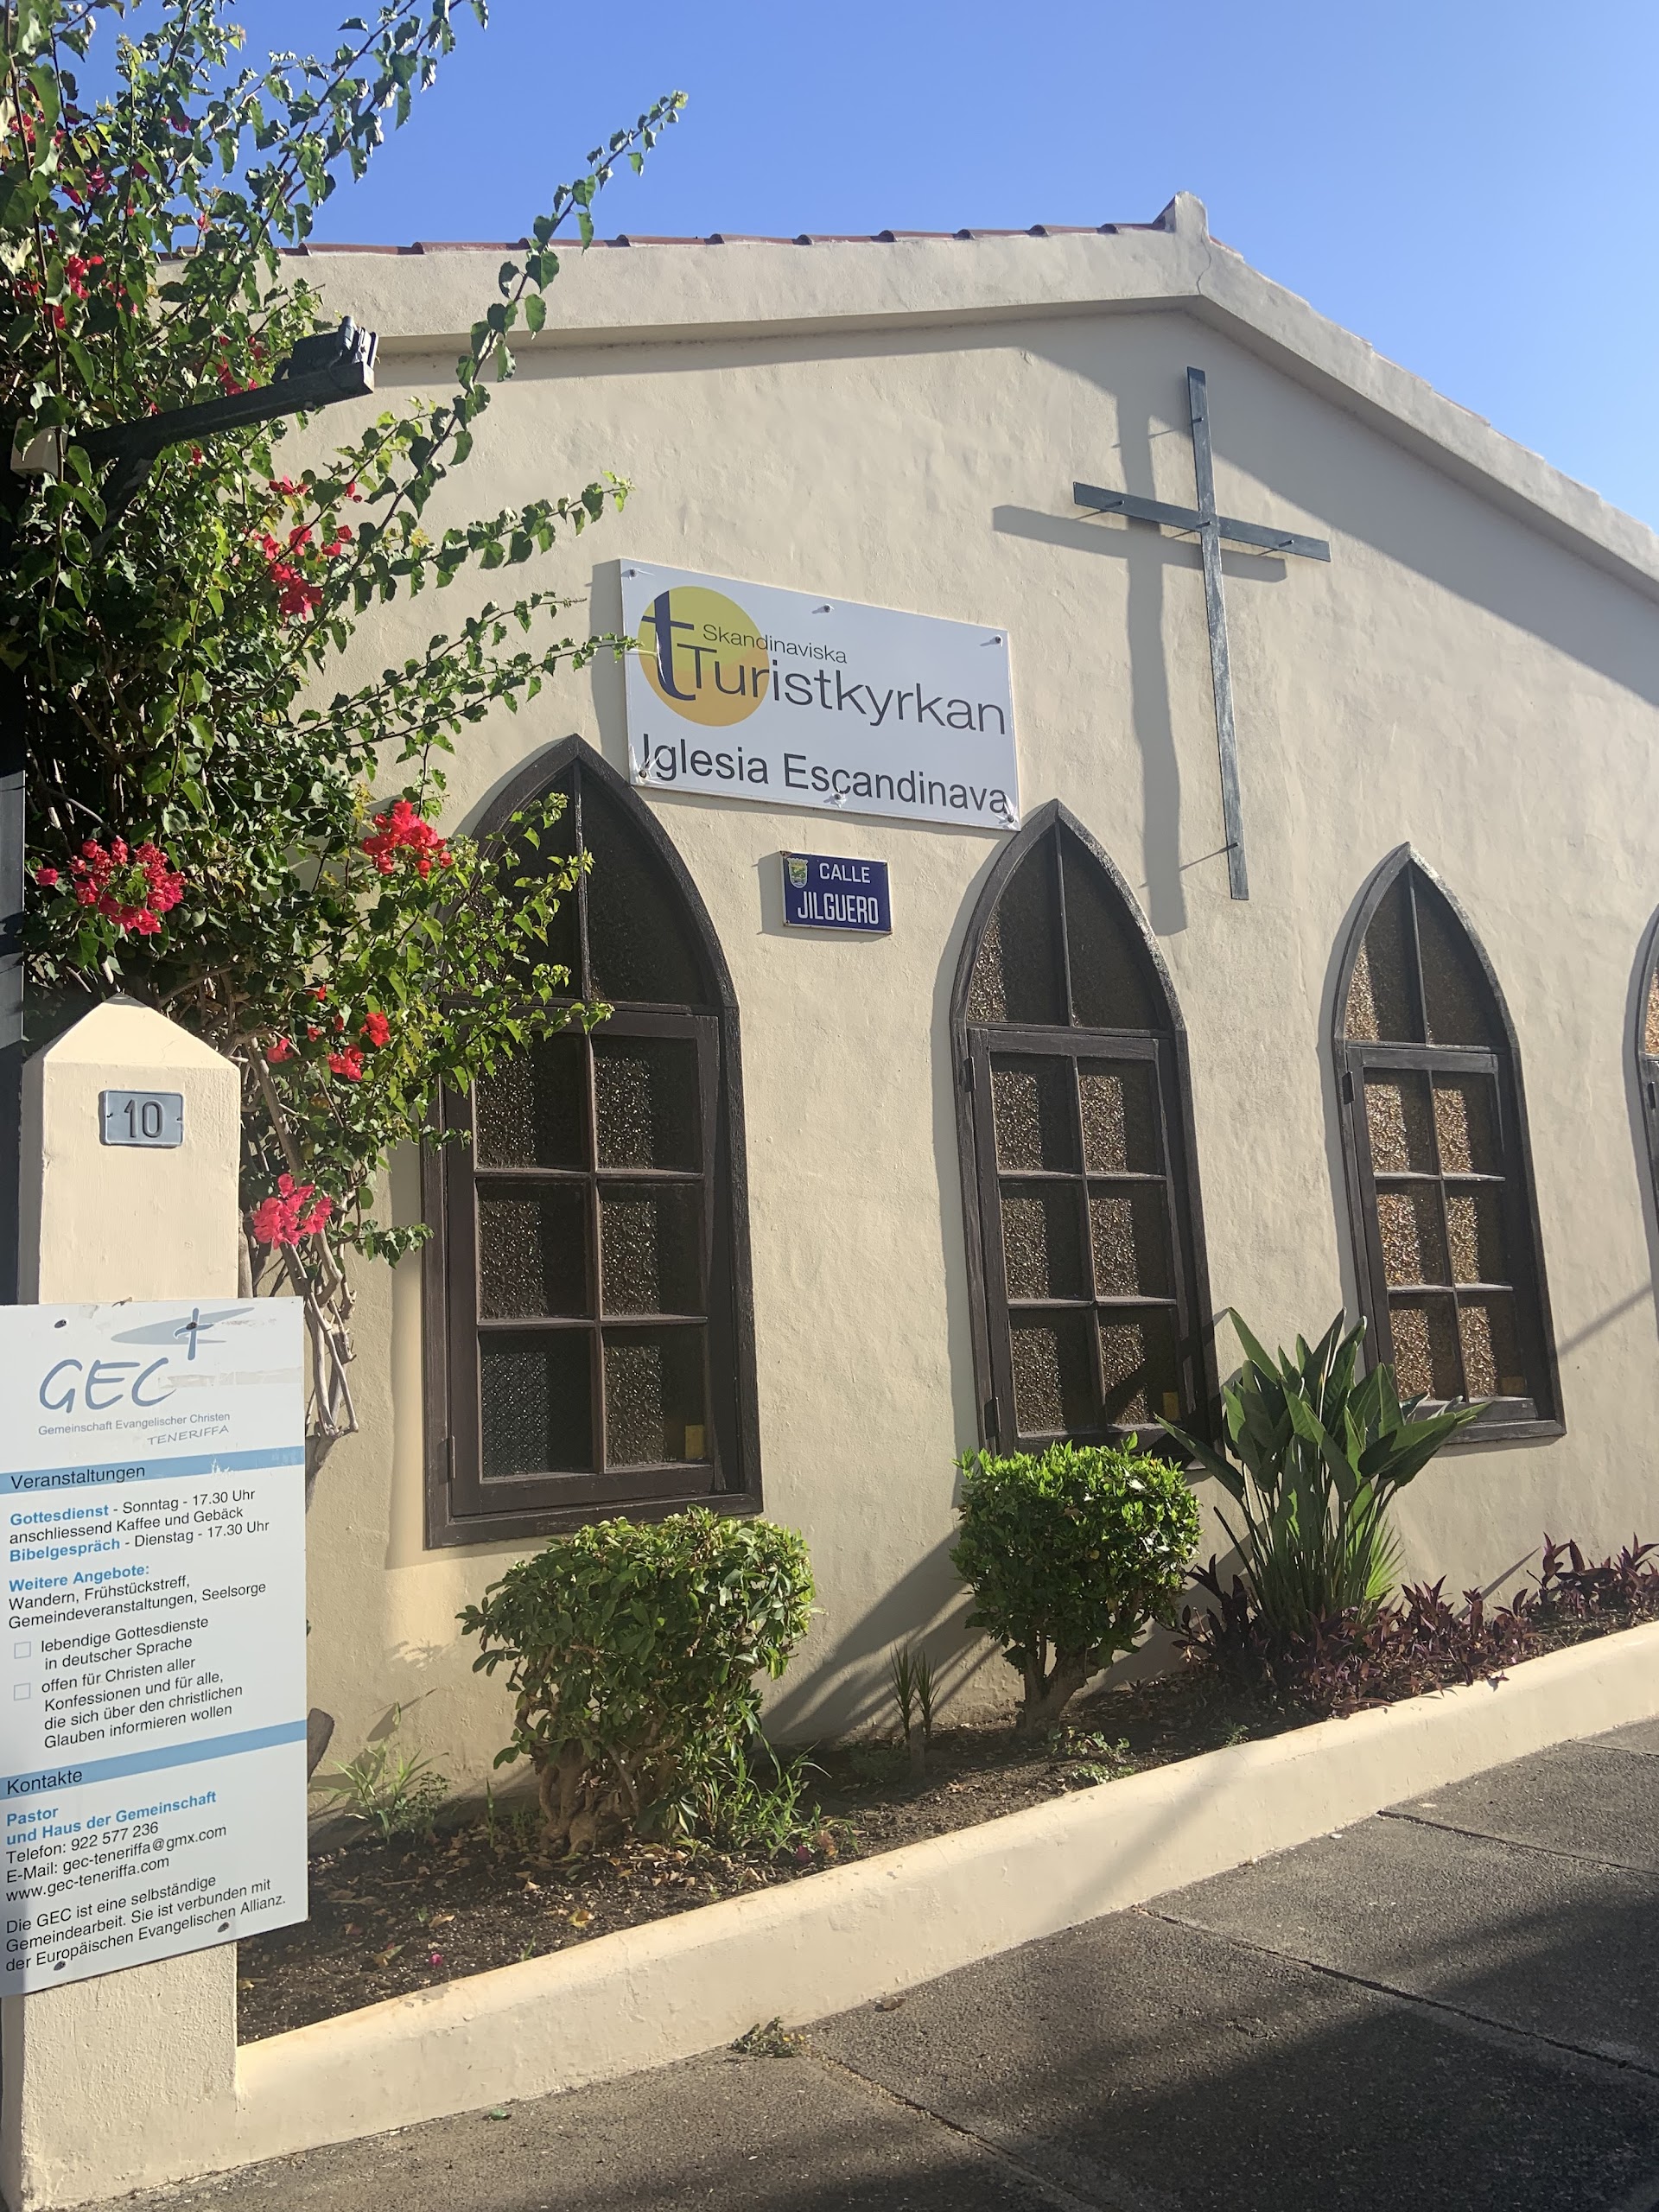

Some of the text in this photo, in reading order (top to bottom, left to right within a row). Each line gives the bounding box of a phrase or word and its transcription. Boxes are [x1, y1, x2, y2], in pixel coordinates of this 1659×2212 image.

[702, 624, 847, 664] Skandinaviska
[677, 643, 1006, 735] Turistkyrkan
[643, 734, 1008, 815] Iglesia Escandinava
[819, 862, 871, 884] CALLE
[798, 891, 879, 925] JILGUERO
[124, 1099, 163, 1138] 10
[39, 1357, 177, 1413] GEC
[38, 1413, 230, 1436] Gemeinschaft Evangelischer Christen
[147, 1426, 229, 1446] TENERIFFA
[10, 1466, 145, 1491] Veranstaltungen
[10, 1504, 109, 1526] Gottesdienst
[123, 1499, 179, 1516] Sonntag
[194, 1491, 228, 1506] 17.30
[232, 1490, 255, 1502] Uhr
[10, 1508, 243, 1544] anschliessend Kaffee und Gebäck
[10, 1538, 120, 1562] Bibelgespräch
[135, 1530, 194, 1548] Dienstag
[207, 1523, 242, 1538] 17.30
[247, 1522, 270, 1533] Uhr
[9, 1566, 149, 1592] Weitere Angebote:
[9, 1575, 190, 1611] Wandern, Frühstückstreff,
[9, 1582, 266, 1629] Gemeindeveranstaltungen, Seelsorge
[41, 1618, 208, 1653] lebendige Gottesdienste
[45, 1637, 192, 1670] in deutscher Sprache
[41, 1657, 195, 1693] offen für Christen aller
[45, 1672, 223, 1712] Konfessionen und für alle,
[45, 1687, 243, 1730] die sich über den christlichen
[45, 1705, 232, 1748] Glauben informieren wollen
[7, 1770, 83, 1795] Kontakte
[7, 1806, 58, 1827] Pastor
[7, 1790, 216, 1846] und Haus der Gemeinschaft
[6, 1821, 158, 1865] Telefon: 922 577 236
[7, 1826, 226, 1884] E-Mail: gec-teneriffa@gmx.com
[6, 1858, 169, 1901] www.gec-teneriffa.com
[6, 1878, 270, 1953] Gemeindearbeit. Sie ist verbunden mit
[7, 1876, 216, 1934] Die GEC ist eine selbständige
[6, 1896, 285, 1972] der Europäischen Evangelischen Allianz.
